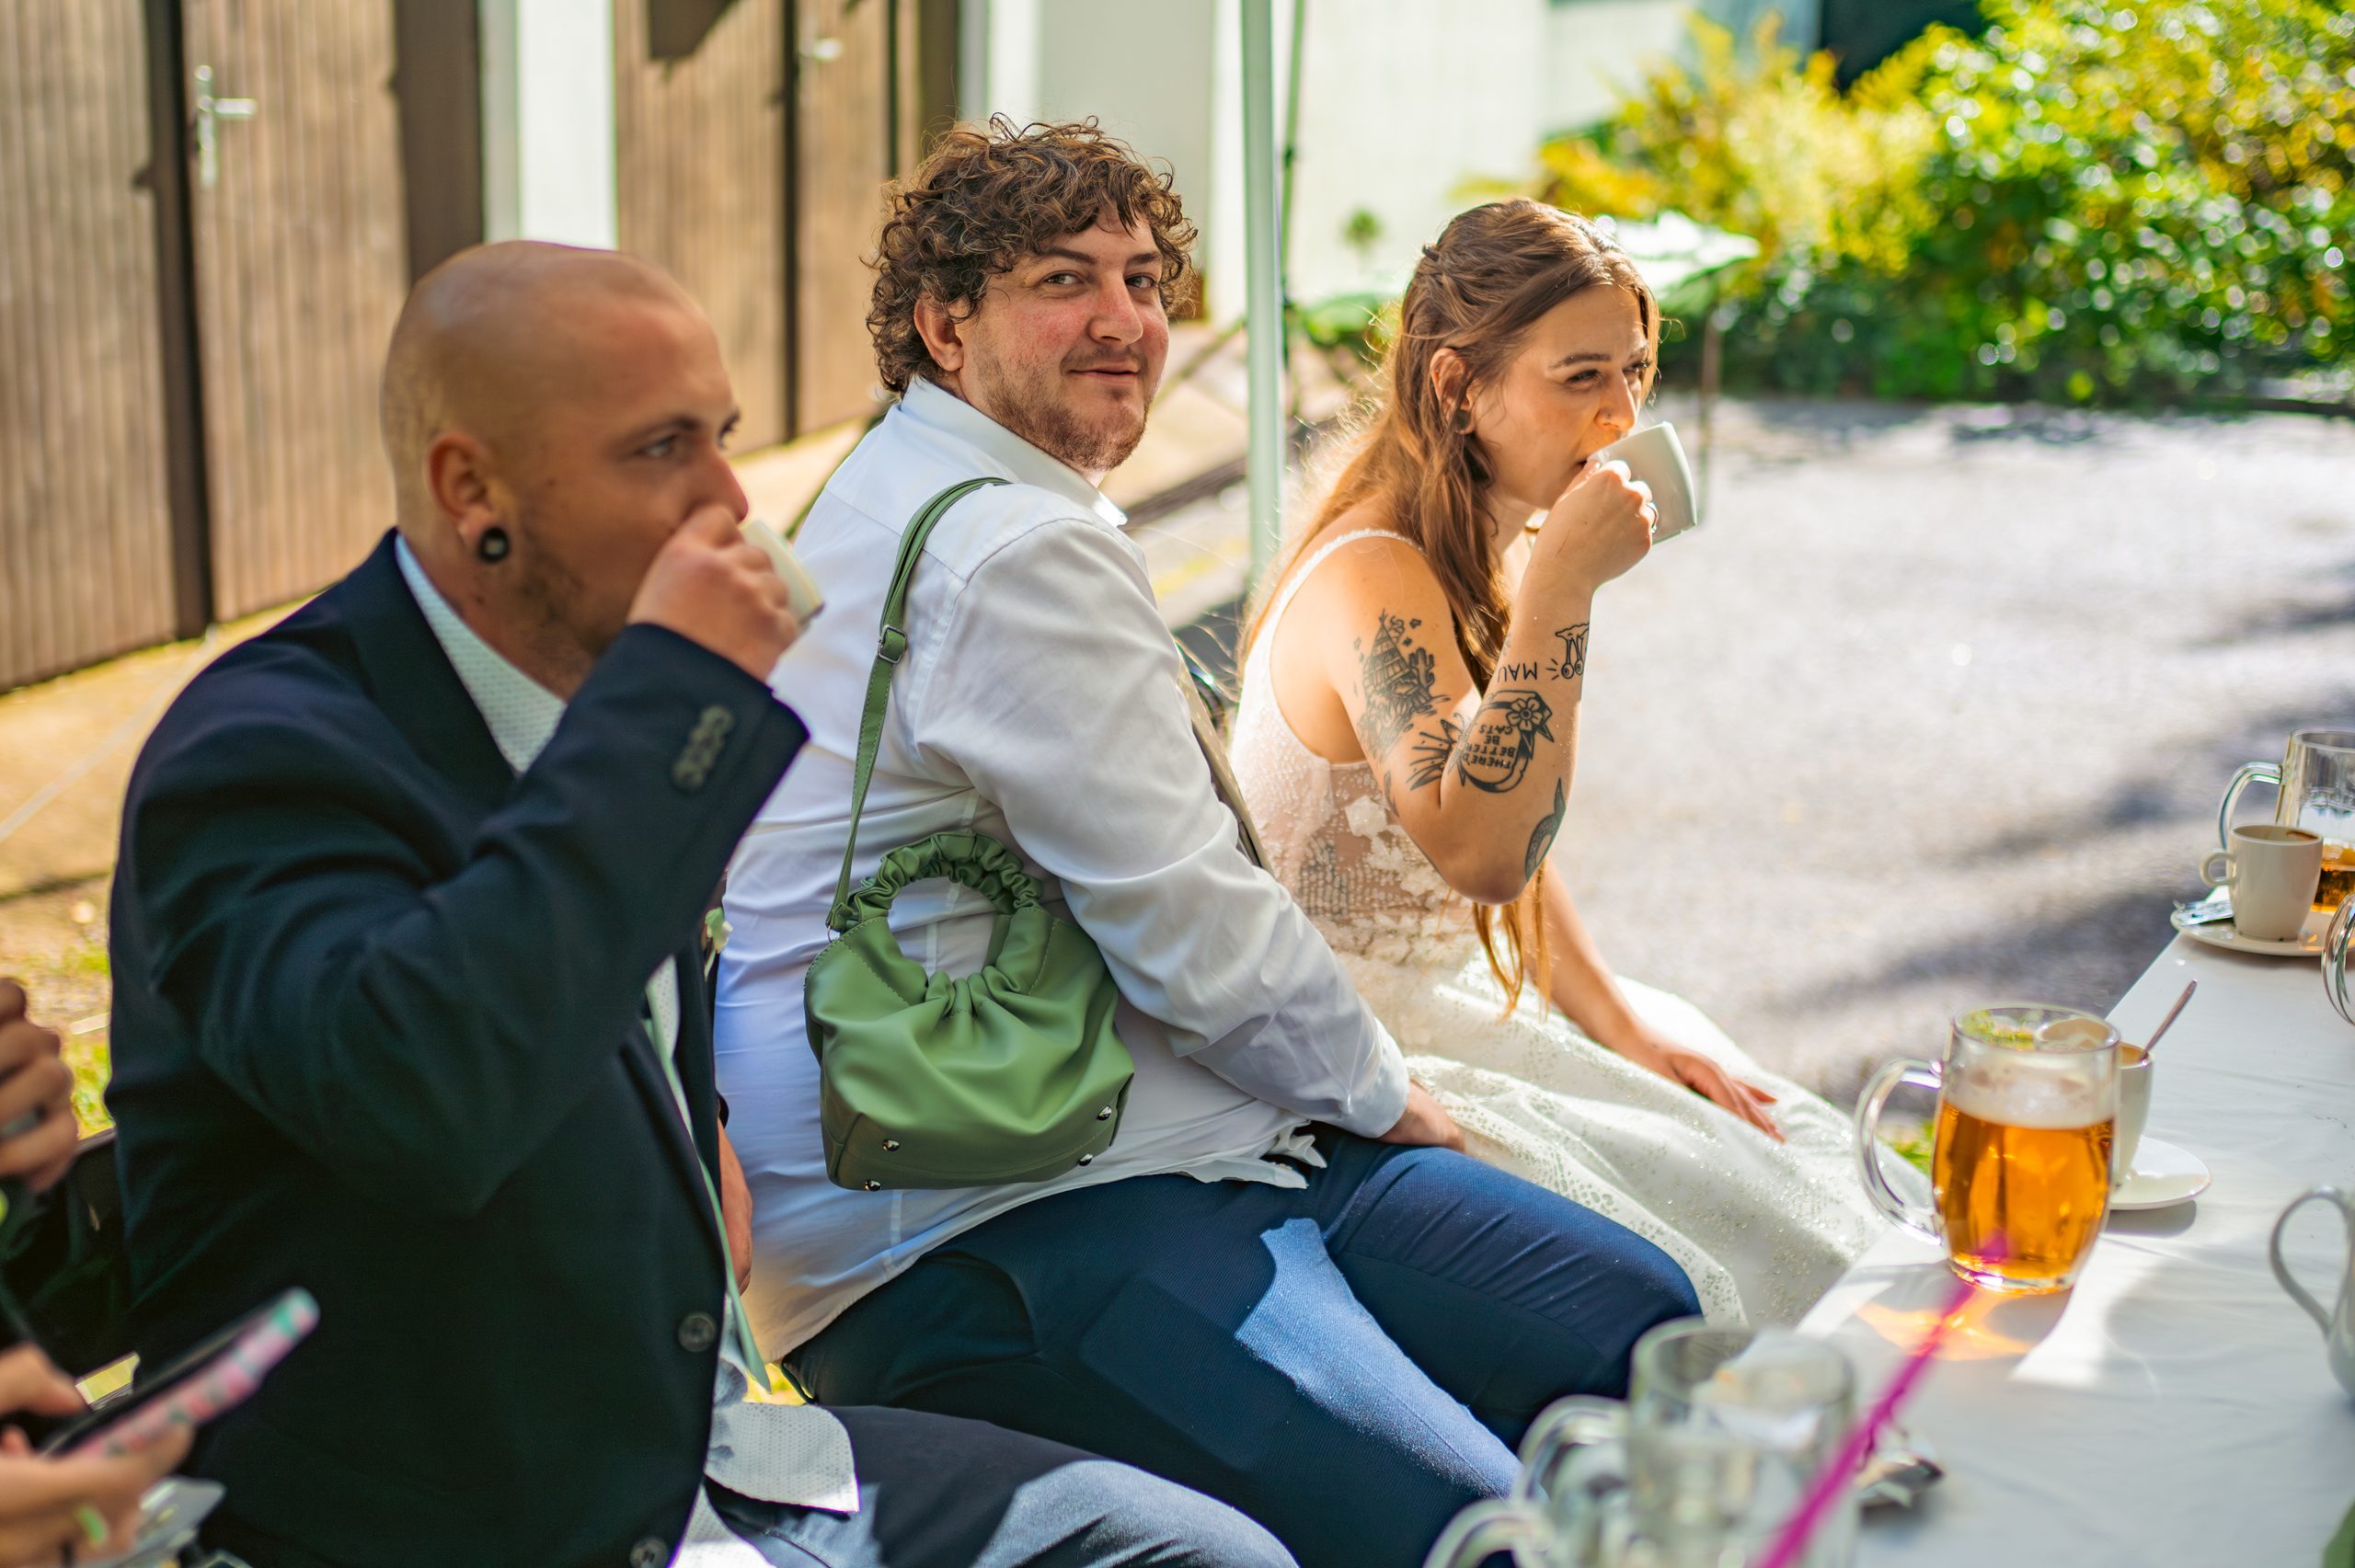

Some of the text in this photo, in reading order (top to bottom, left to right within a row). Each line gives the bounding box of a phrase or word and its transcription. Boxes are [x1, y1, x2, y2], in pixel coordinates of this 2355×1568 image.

[1498, 661, 1537, 682] MAU
[1479, 724, 1513, 735] CATS
[1484, 735, 1500, 745] BE
[1465, 743, 1516, 758] BETTER
